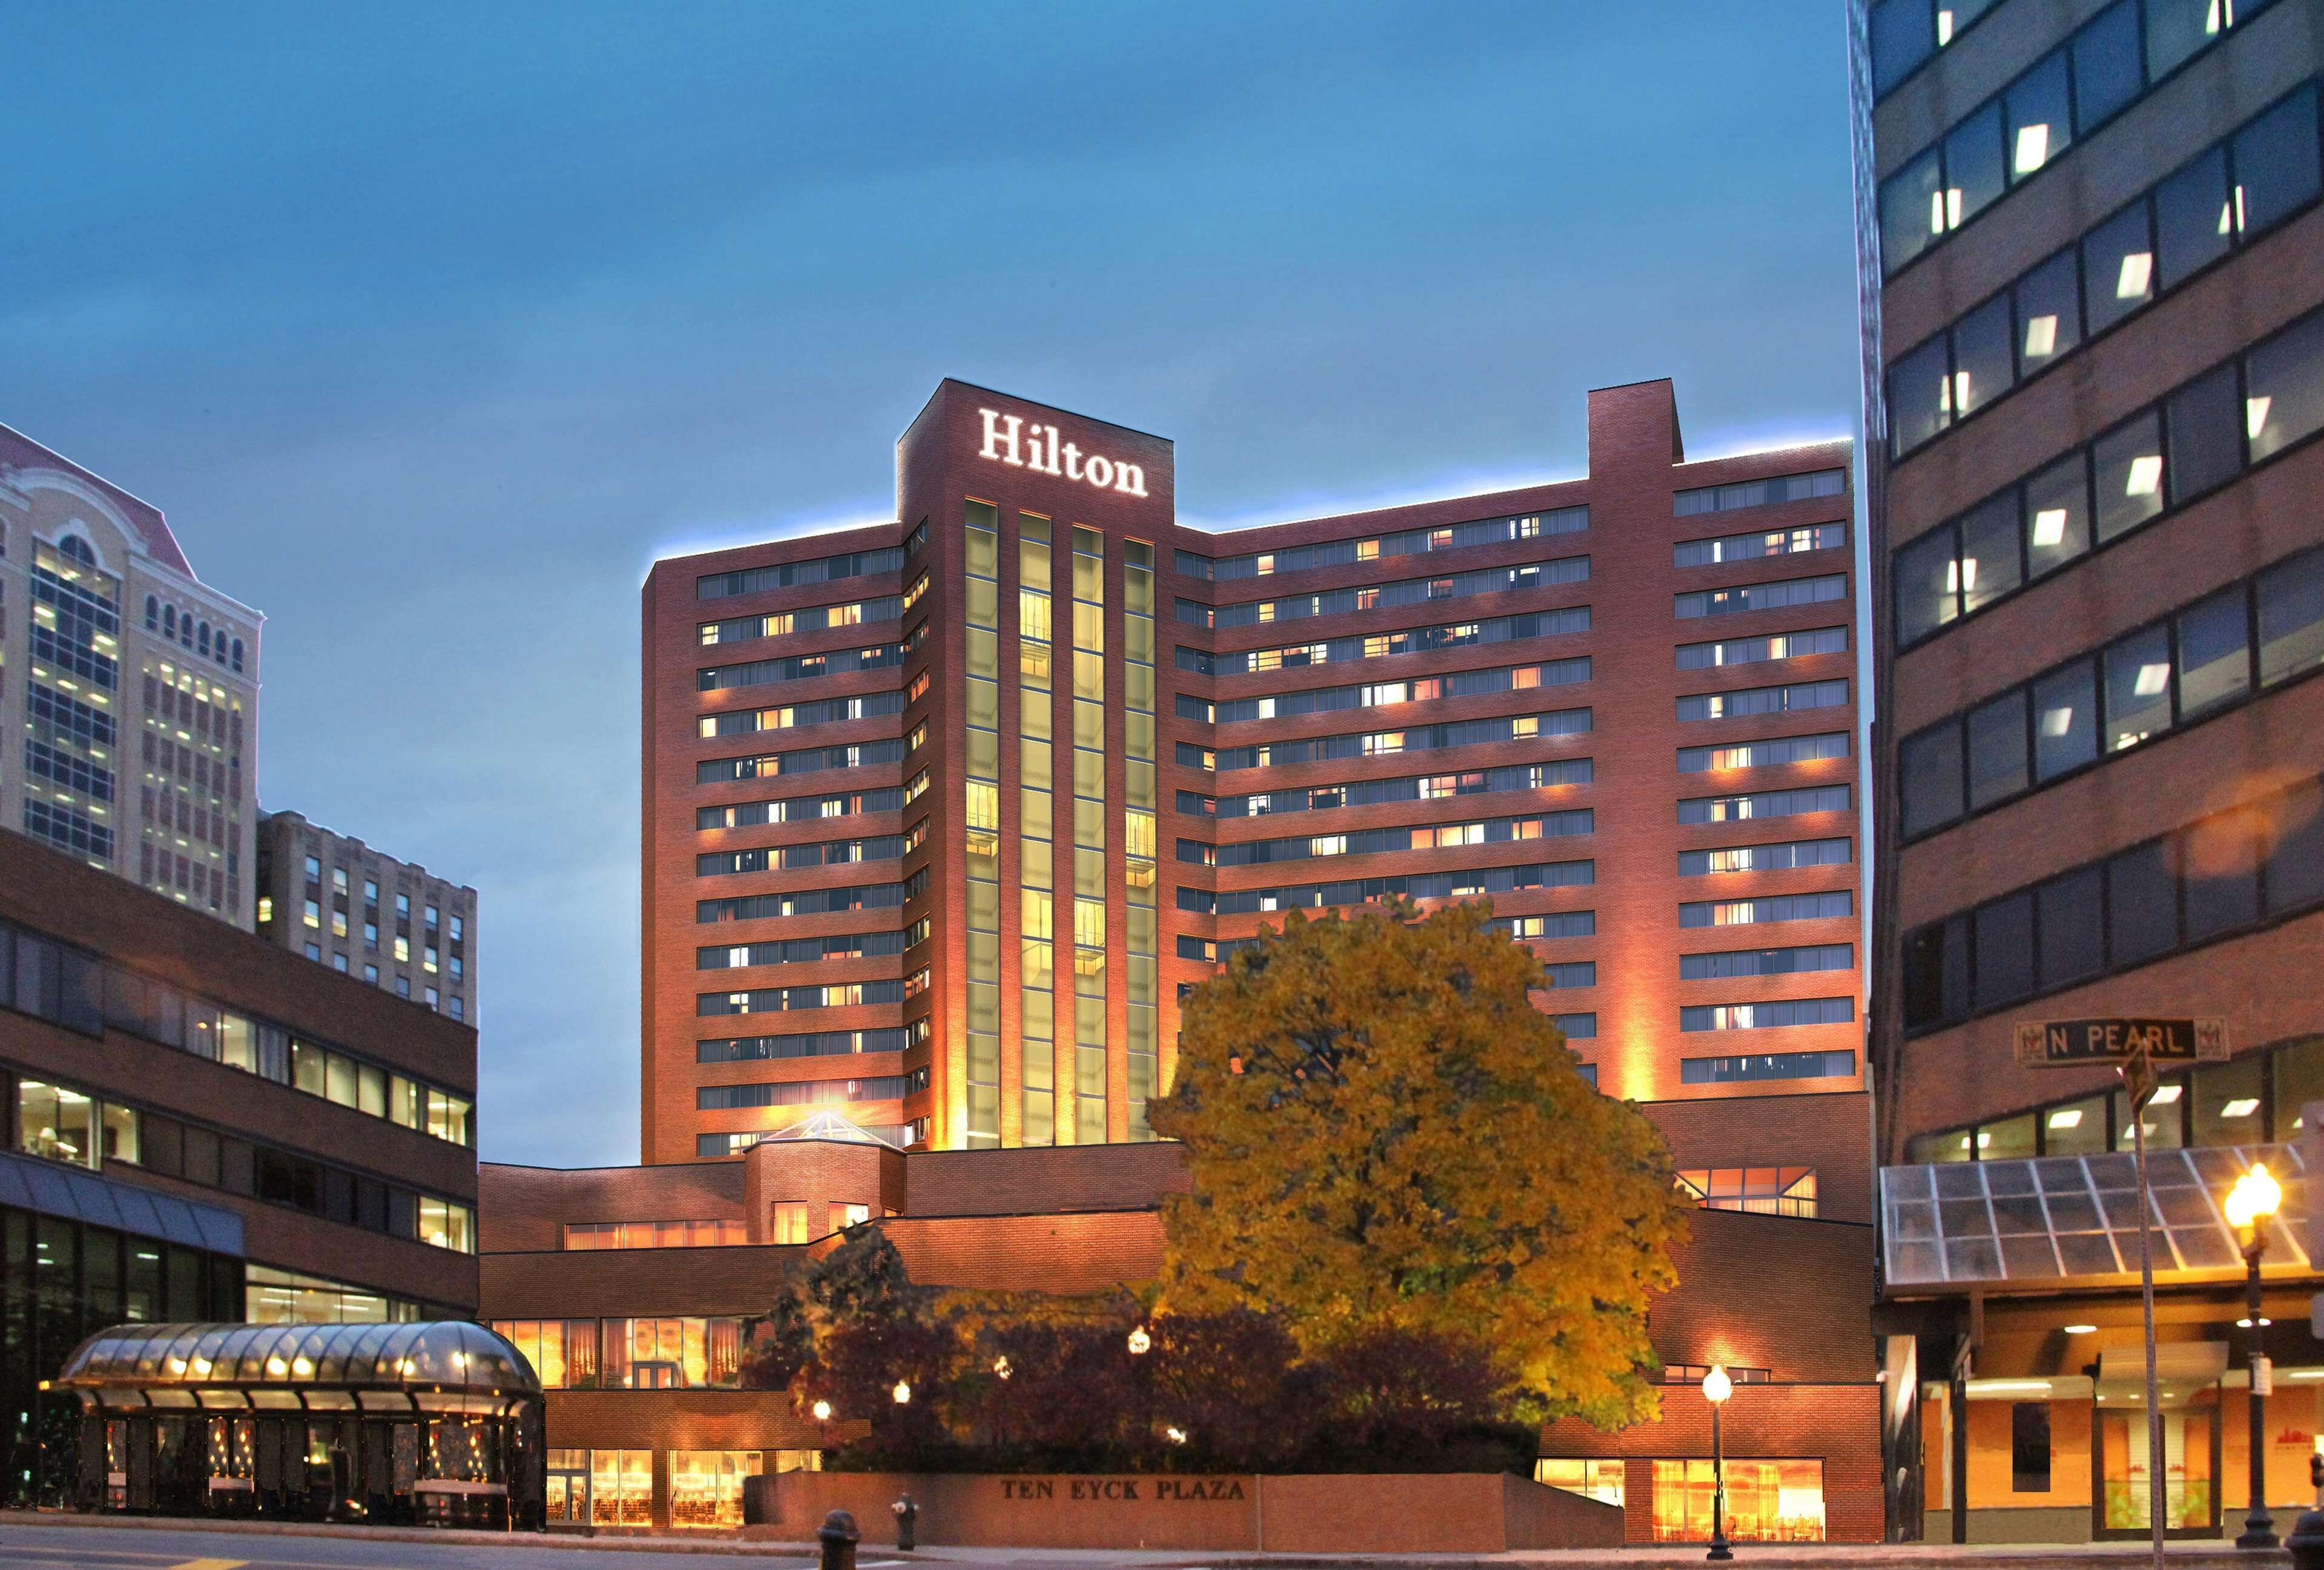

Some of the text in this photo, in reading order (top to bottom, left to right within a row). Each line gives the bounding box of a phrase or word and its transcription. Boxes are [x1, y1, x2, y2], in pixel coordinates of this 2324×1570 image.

[978, 408, 1148, 498] Hilton
[2050, 1025, 2184, 1054] N PEARL
[1001, 1480, 1245, 1500] TEN EYCK PLAZA
